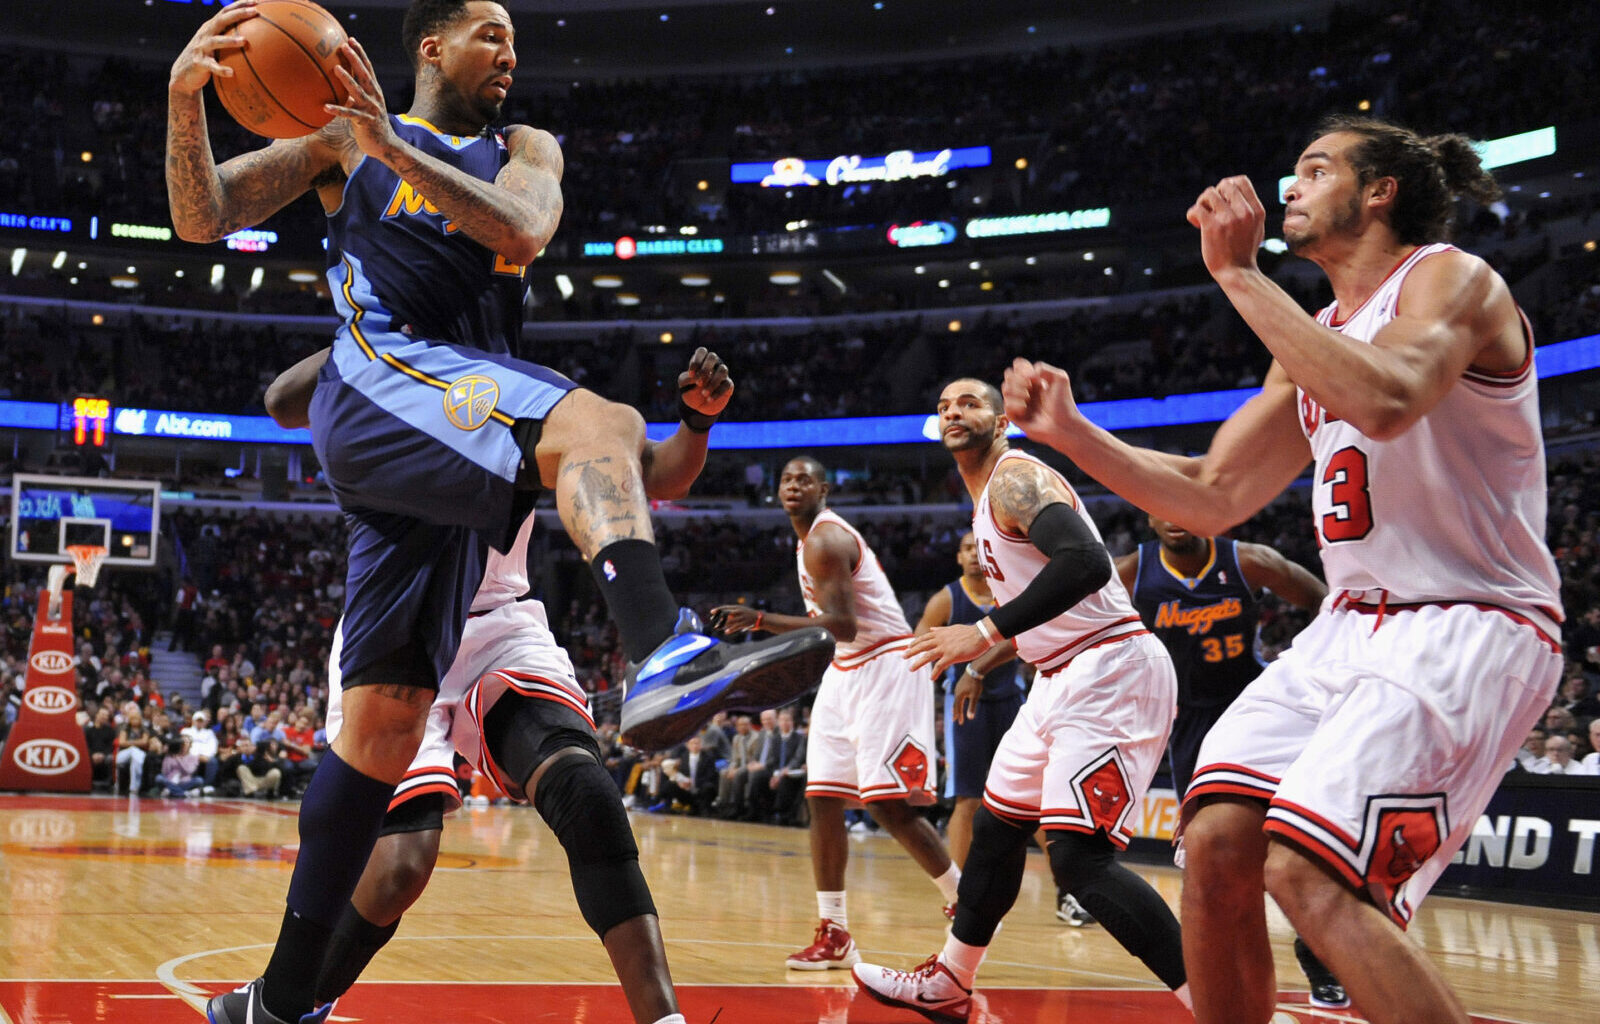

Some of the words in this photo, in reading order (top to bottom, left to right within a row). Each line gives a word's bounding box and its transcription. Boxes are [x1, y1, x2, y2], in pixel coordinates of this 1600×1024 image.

[155, 413, 232, 438] Abt.com
[1314, 445, 1375, 545] 3
[1155, 598, 1242, 635] Nuggets
[1202, 633, 1245, 662] 35
[38, 656, 68, 668] KIA
[33, 692, 68, 707] KIA
[25, 747, 69, 767] KIA
[1451, 814, 1552, 870] ND
